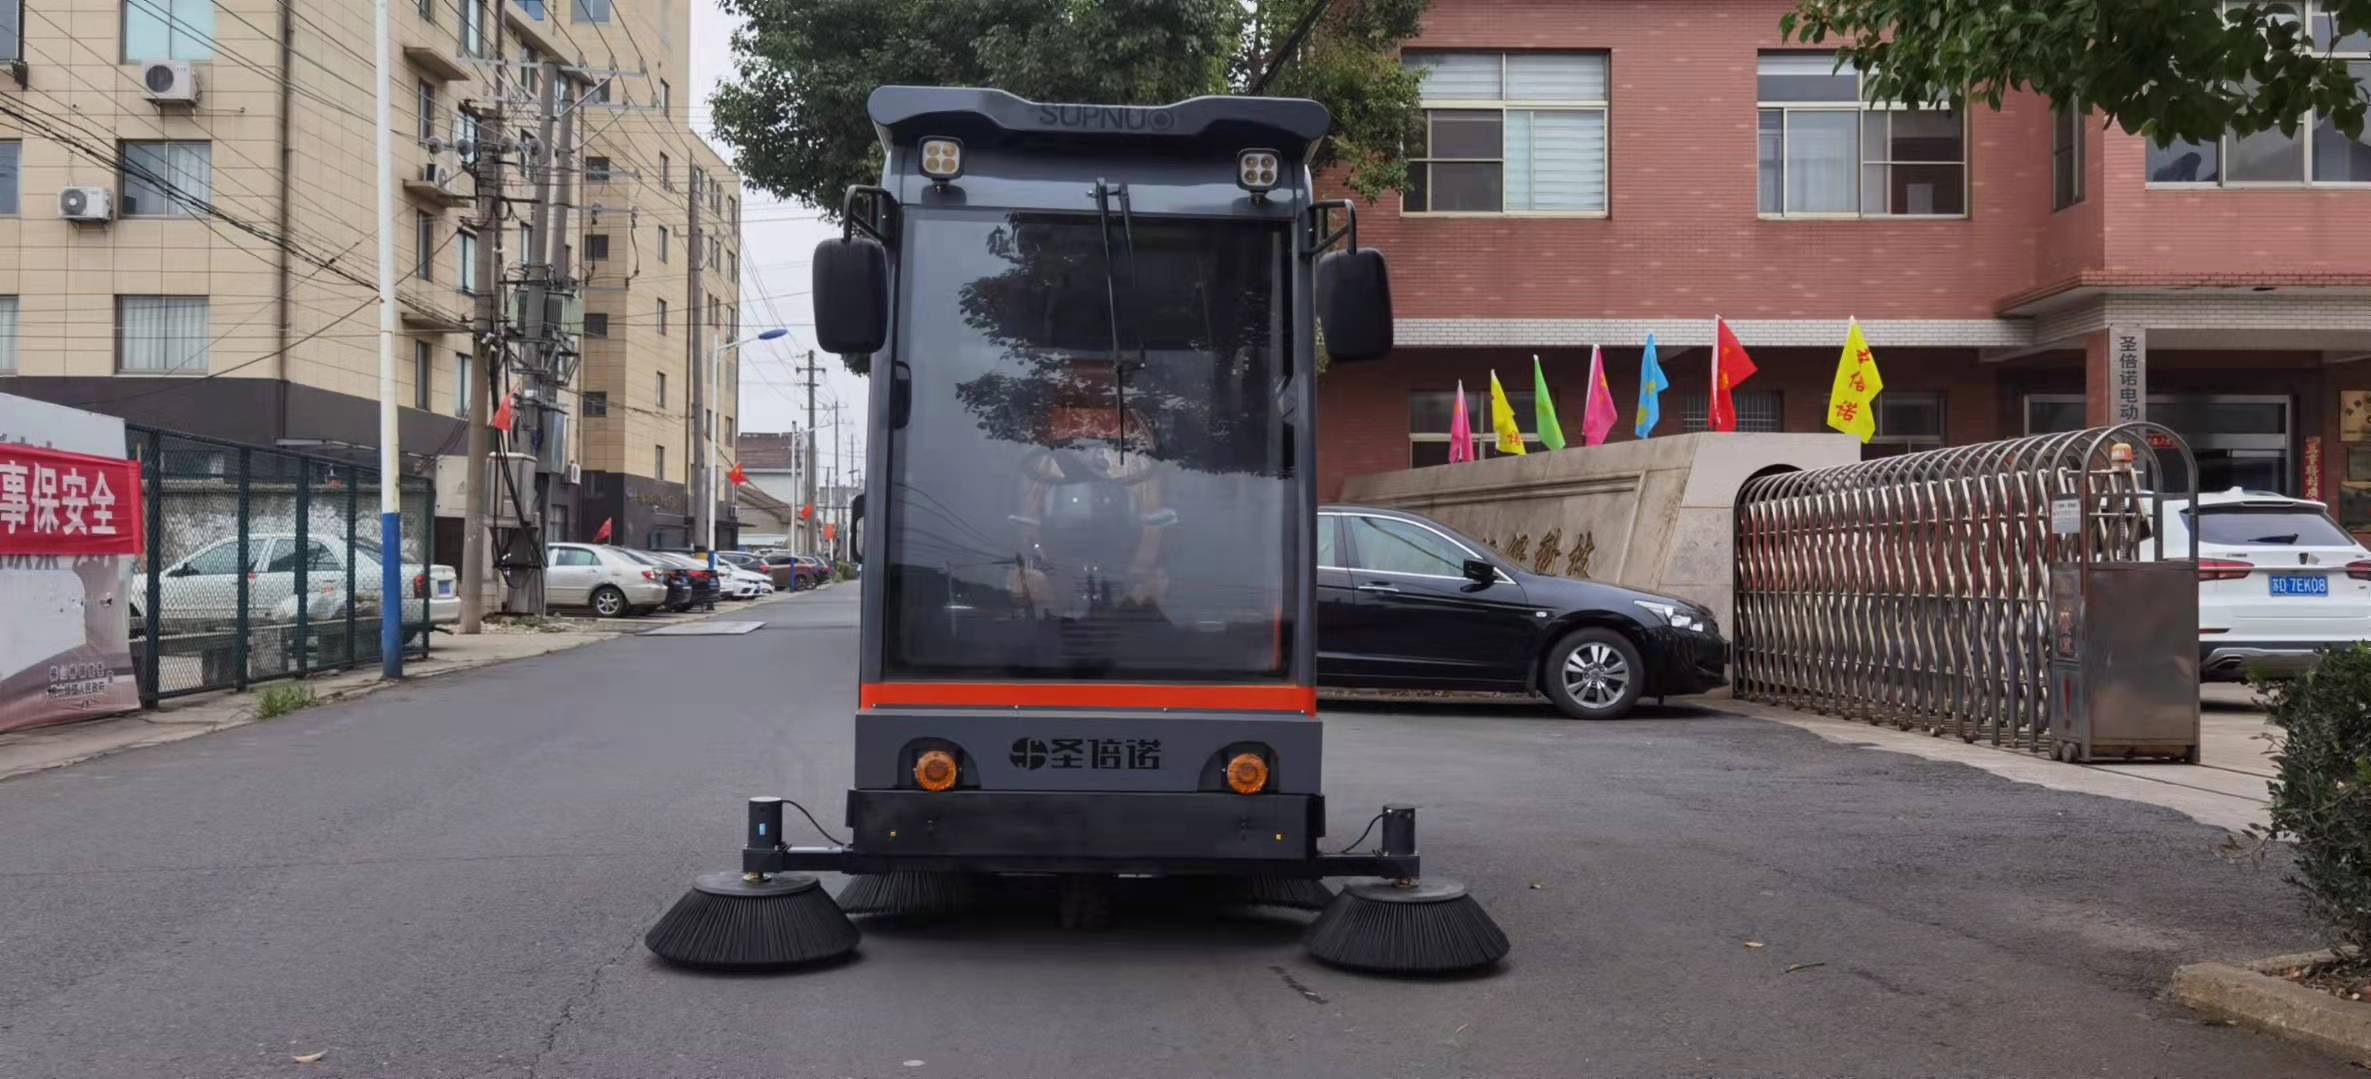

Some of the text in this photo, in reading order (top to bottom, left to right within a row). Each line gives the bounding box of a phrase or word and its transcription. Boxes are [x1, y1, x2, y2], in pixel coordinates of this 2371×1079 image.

[0, 460, 116, 535] 事保安全
[1051, 738, 1161, 770] 圣倍诺
